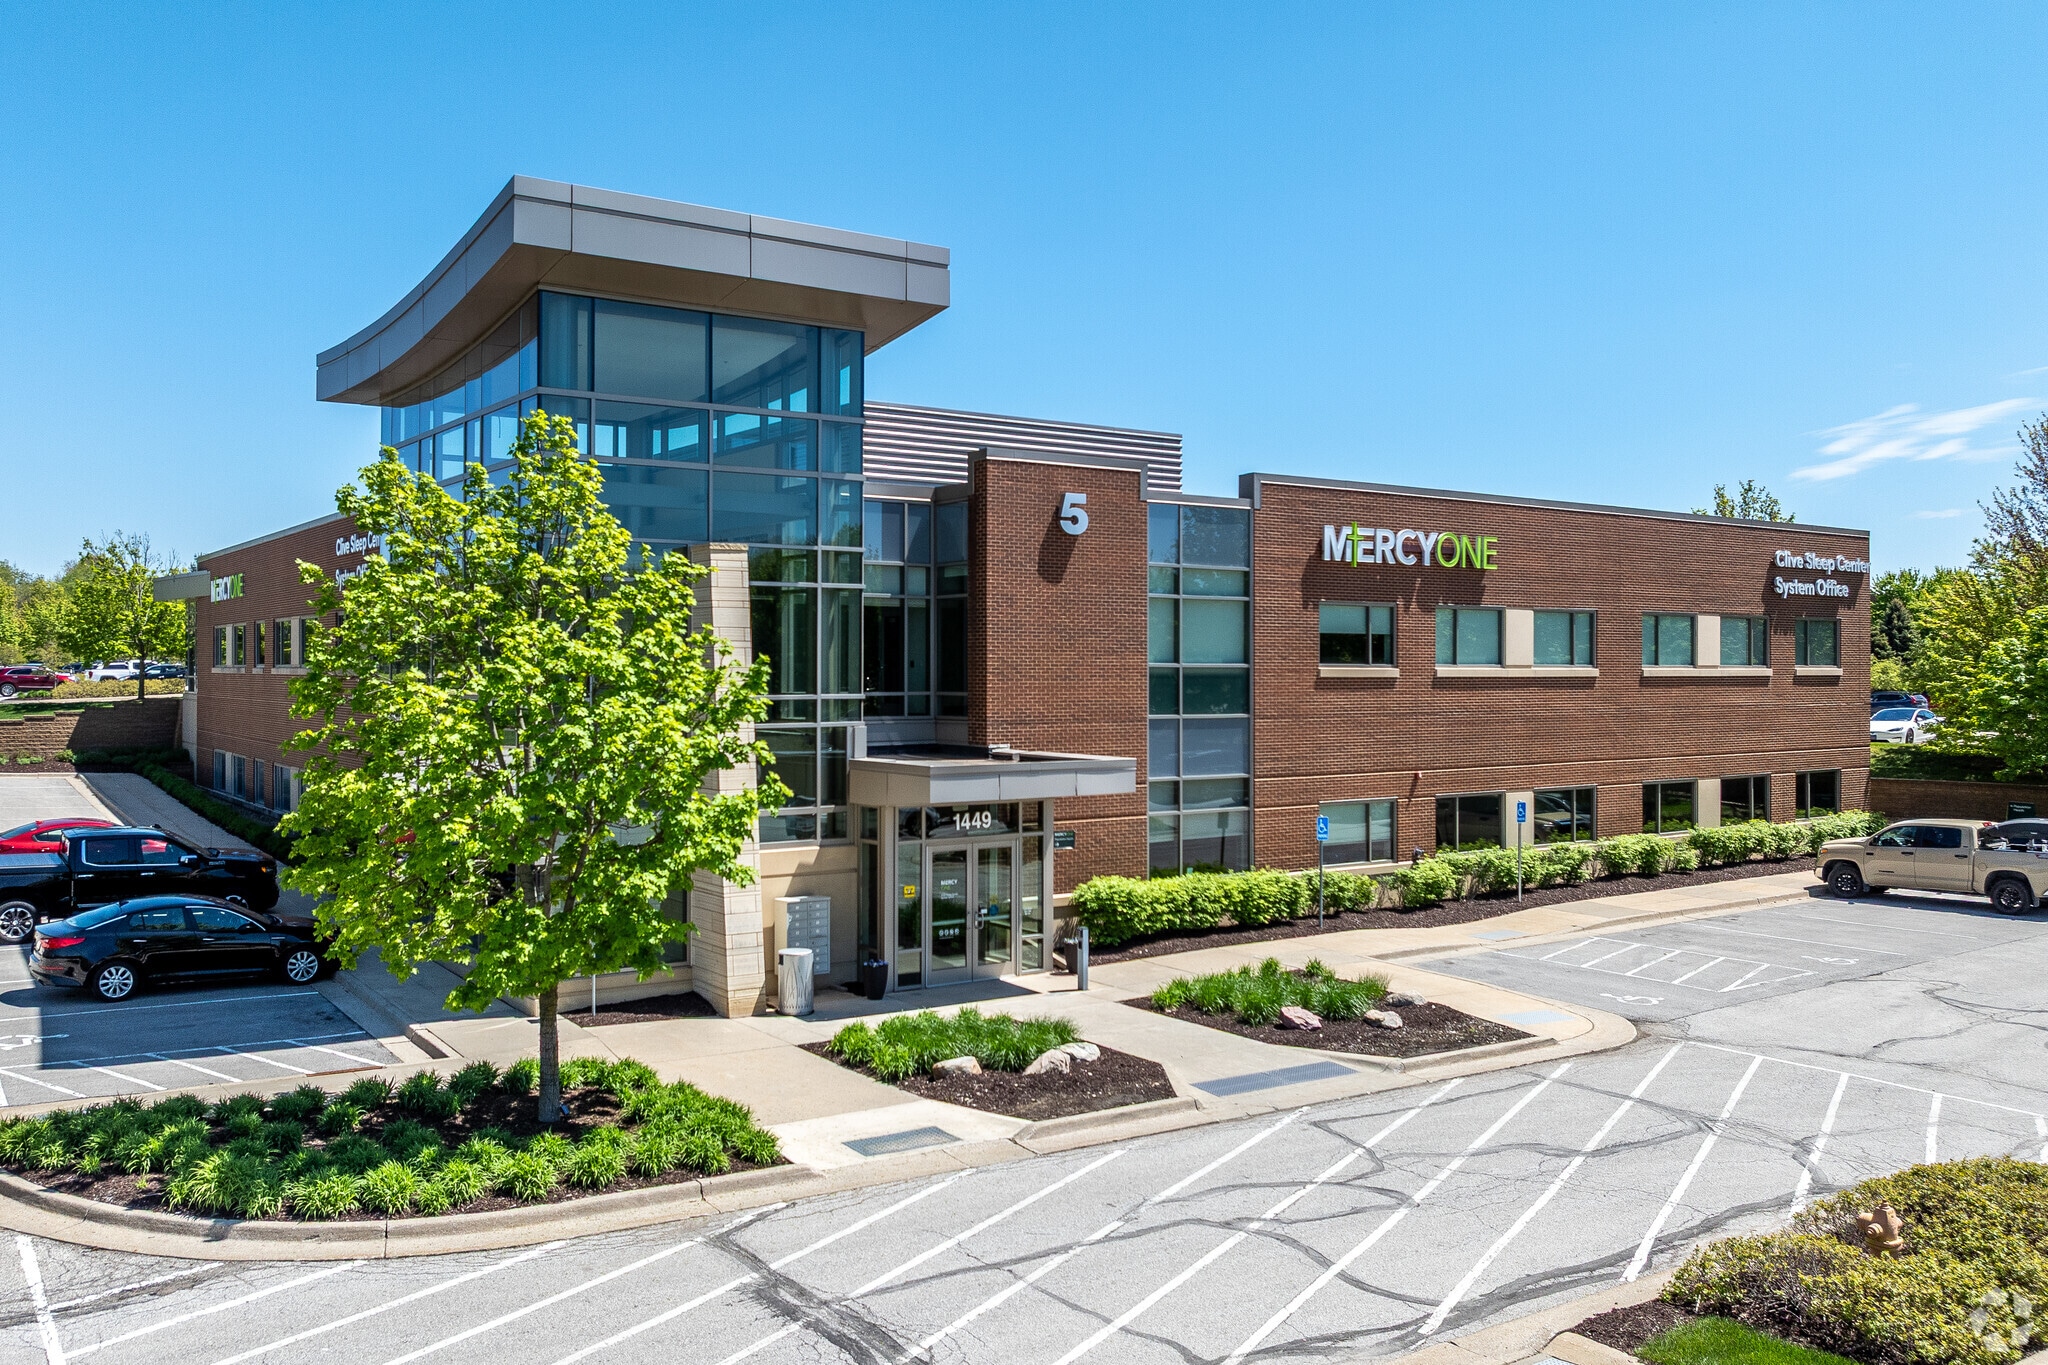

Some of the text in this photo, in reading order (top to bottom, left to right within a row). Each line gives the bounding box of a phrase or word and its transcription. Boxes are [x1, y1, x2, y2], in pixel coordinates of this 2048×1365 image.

[1059, 492, 1089, 536] 5
[367, 530, 380, 549] Cen
[1775, 550, 1870, 575] Clive Sleep Center
[1774, 576, 1849, 599] System Office
[953, 811, 992, 831] 1449
